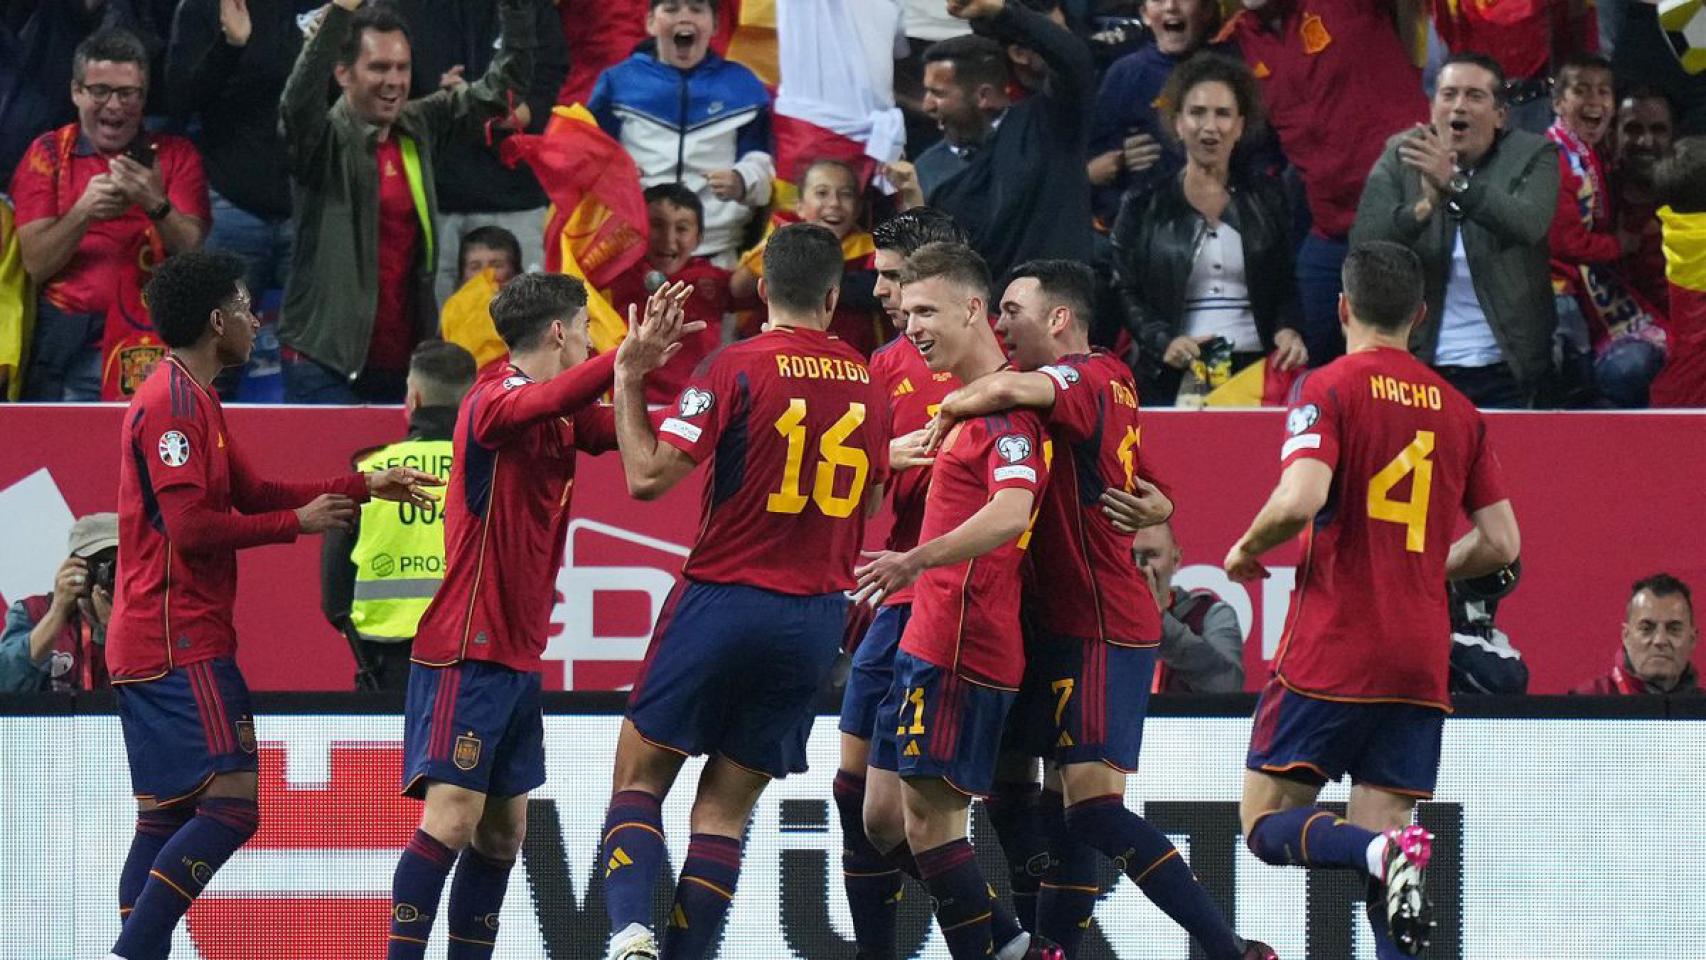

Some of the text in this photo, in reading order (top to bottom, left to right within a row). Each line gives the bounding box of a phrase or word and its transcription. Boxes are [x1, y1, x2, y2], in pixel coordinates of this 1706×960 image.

[776, 354, 870, 384] RODRIGO
[1370, 375, 1441, 411] NACHO
[766, 398, 869, 518] 16
[1366, 430, 1435, 553] 4
[398, 498, 445, 525] 00
[400, 555, 446, 572] PRO
[1052, 677, 1075, 727] 7
